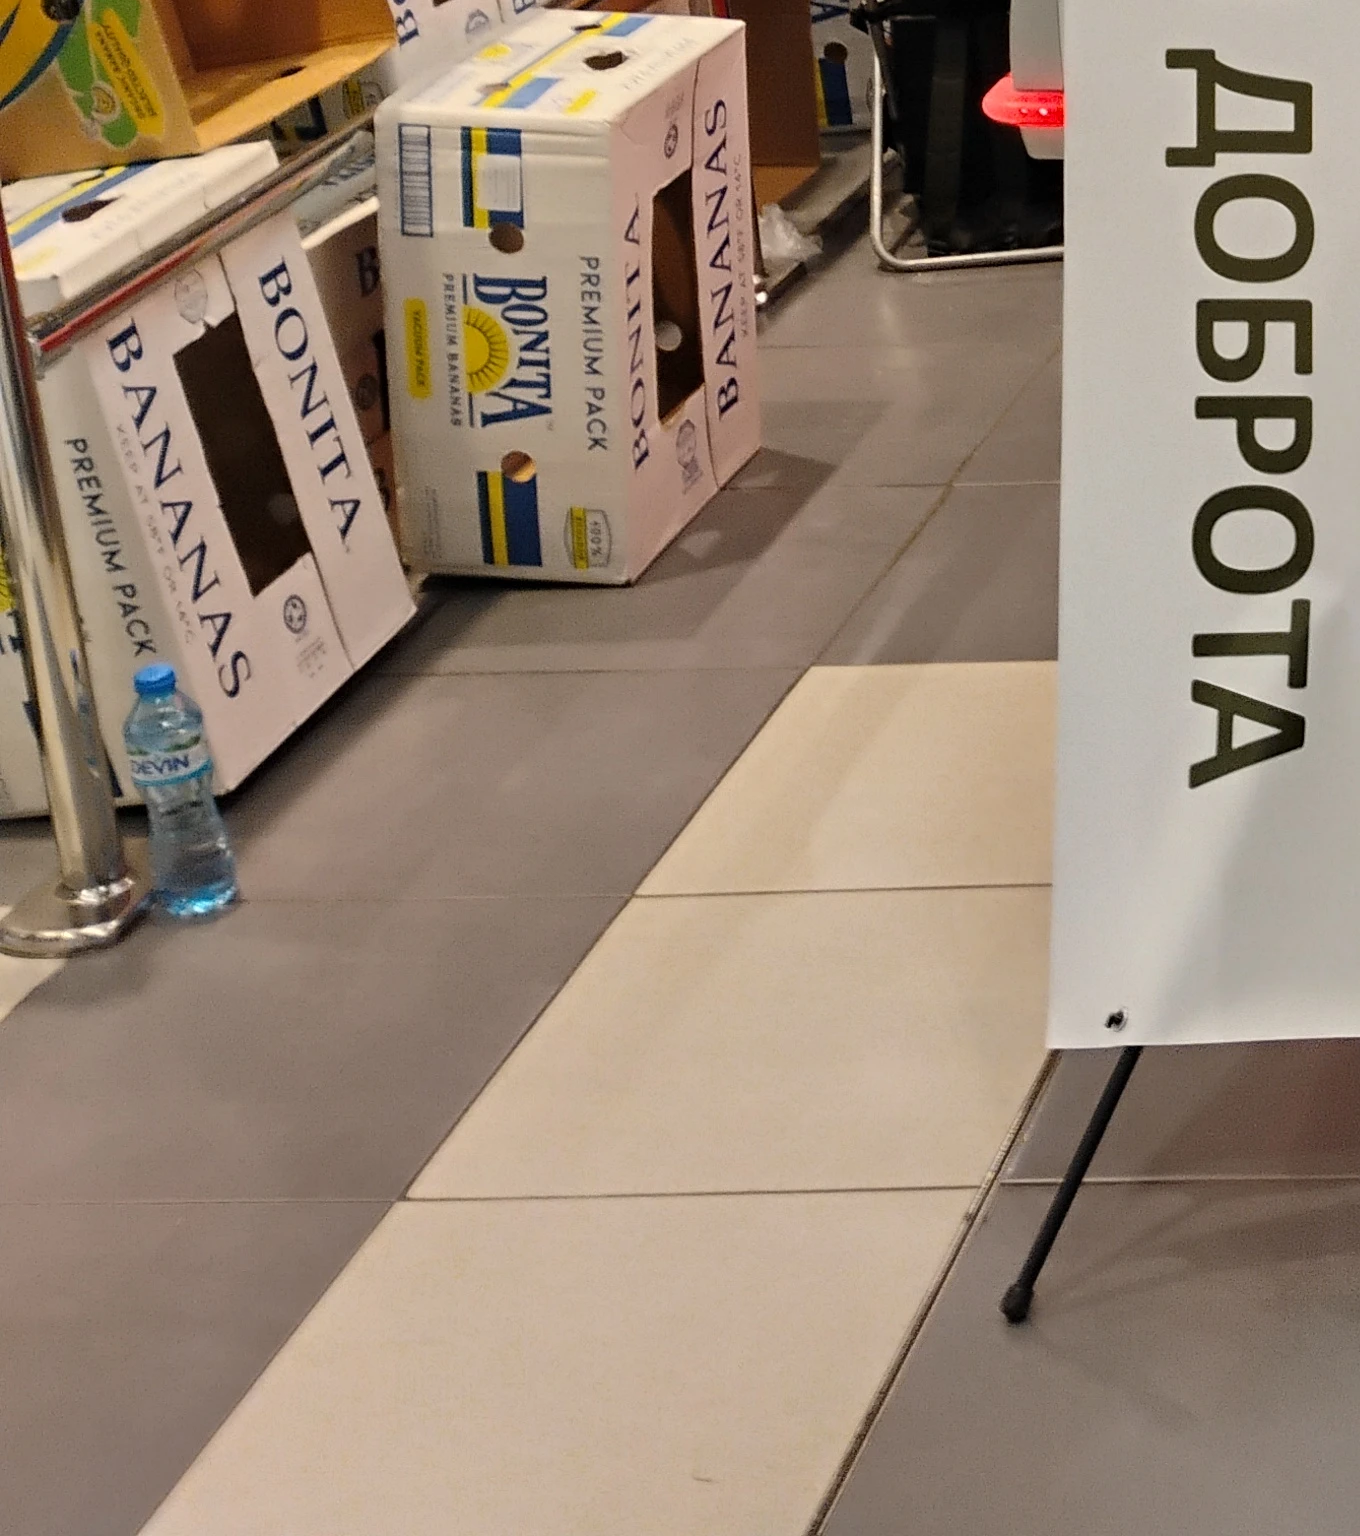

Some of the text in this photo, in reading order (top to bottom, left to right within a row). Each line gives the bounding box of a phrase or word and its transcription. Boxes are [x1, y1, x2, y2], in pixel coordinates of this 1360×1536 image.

[441, 272, 462, 428] PREMIUM BANANAS
[472, 273, 553, 429] BONITA
[578, 254, 609, 452] PREMIUM PACK
[624, 196, 649, 472] BONITA
[704, 98, 740, 422] BANANAS
[105, 317, 253, 699] BANANAS
[257, 256, 363, 542] BONITA
[1166, 48, 1315, 788] ДОБРОТА
[64, 436, 158, 658] PREMIUM PACK
[131, 753, 190, 776] DEVIN
